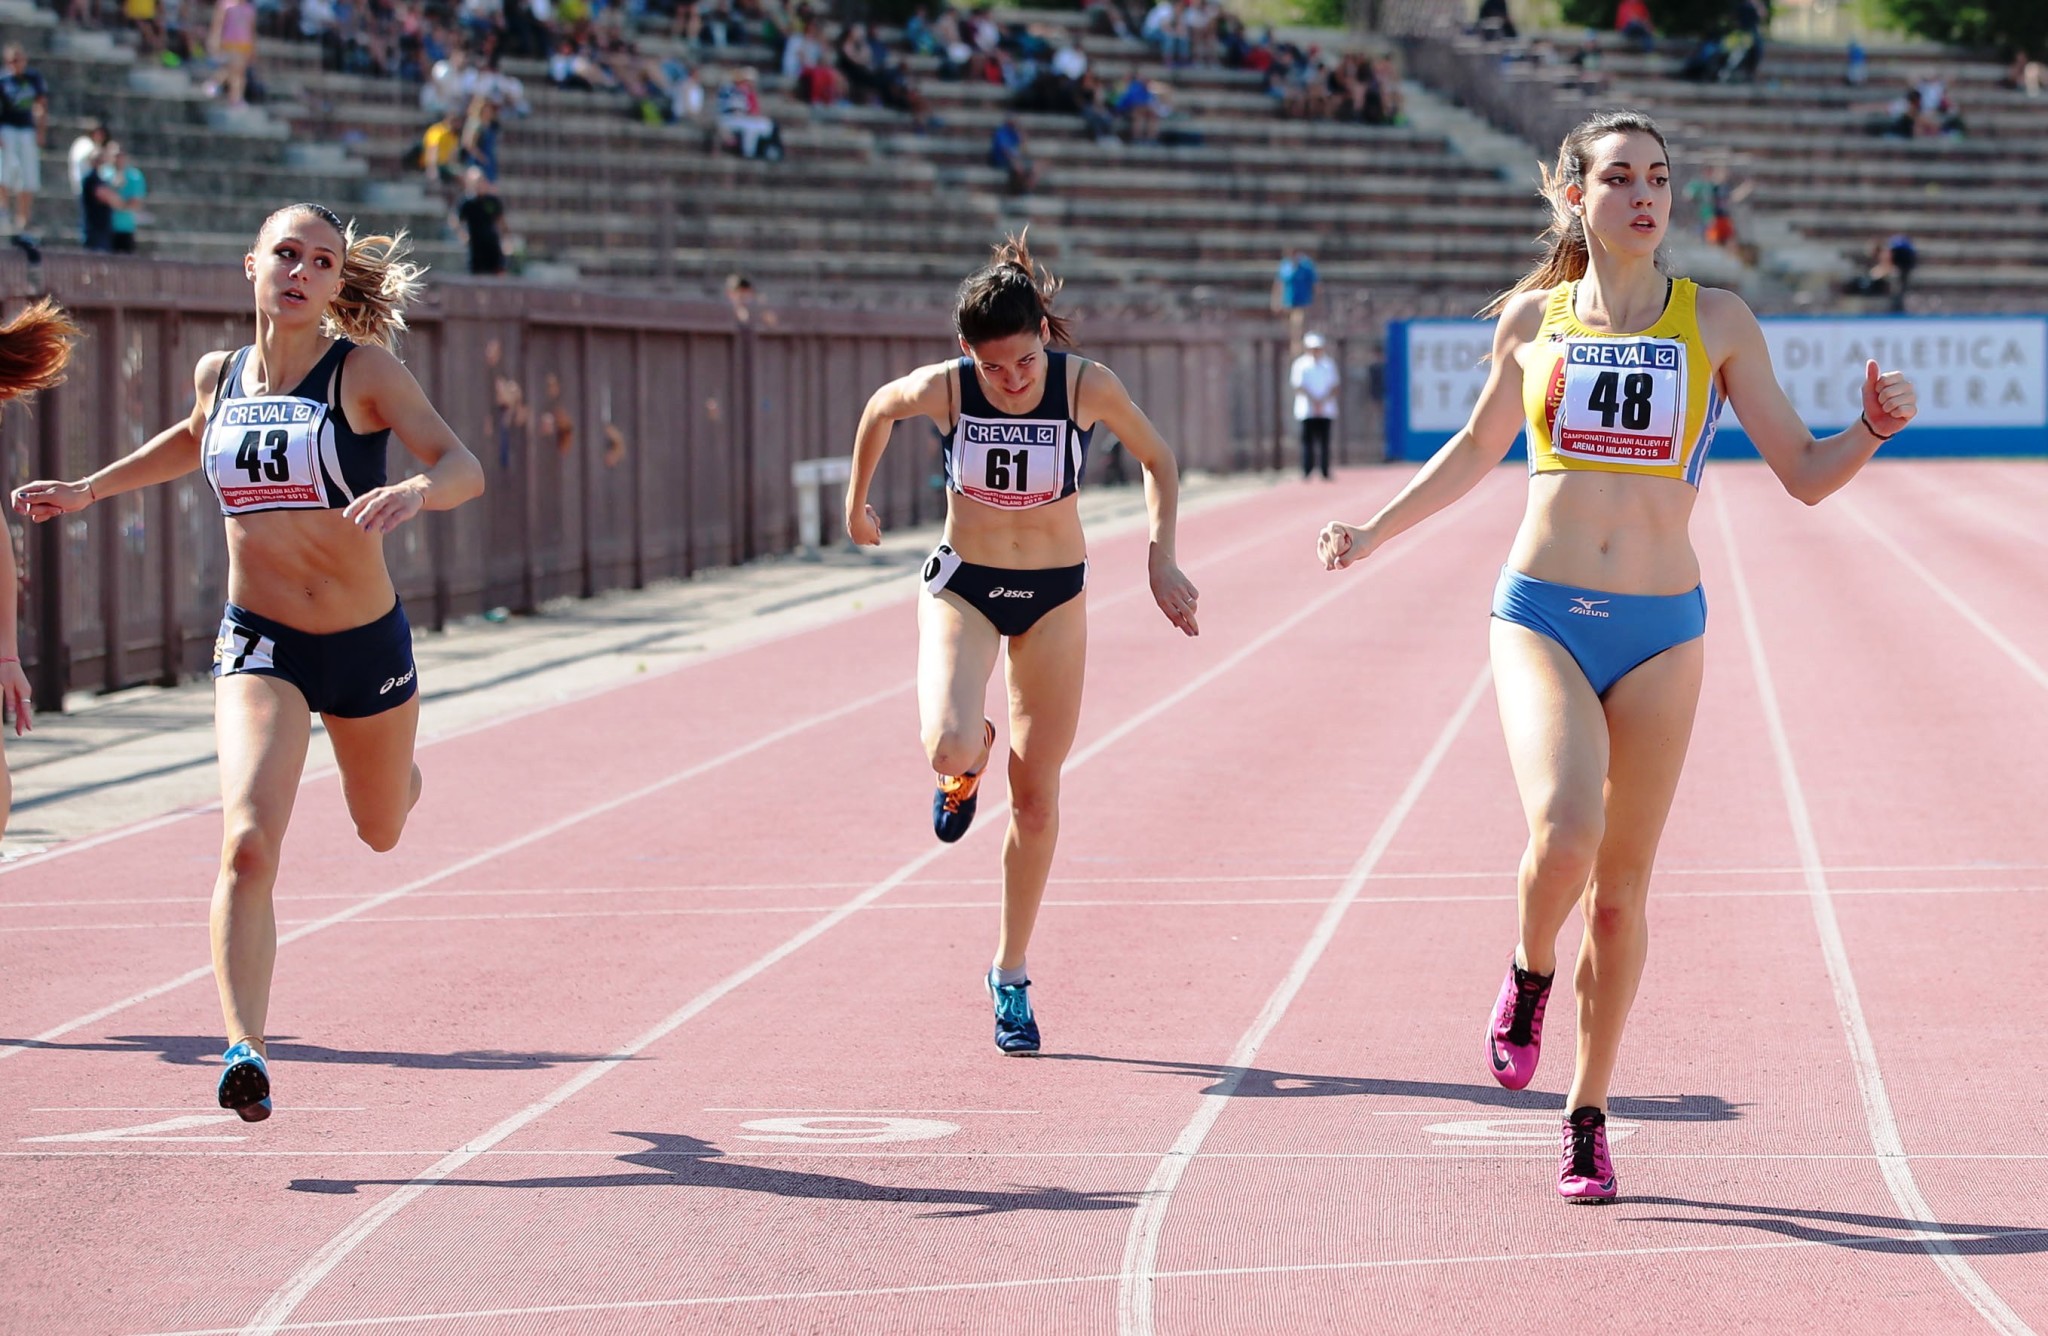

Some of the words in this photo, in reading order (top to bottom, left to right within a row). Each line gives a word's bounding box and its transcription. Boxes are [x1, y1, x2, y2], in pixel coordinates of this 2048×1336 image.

[1572, 345, 1651, 366] CREVAL
[1784, 336, 1820, 370] DI
[1844, 336, 2027, 370] ATLETICA
[1588, 371, 1653, 430] 48
[226, 404, 289, 424] CREVAL
[967, 424, 1033, 443] CREVAL
[1562, 432, 1605, 442] CAMPIONATI
[1605, 435, 1634, 445] ITALIANI
[1635, 439, 1660, 447] ALLIEVI
[235, 429, 290, 482] 43
[1571, 441, 1595, 452] ARENA
[1596, 445, 1604, 453] DI
[1605, 447, 1632, 455] MILANO
[1634, 448, 1658, 457] 2015
[985, 448, 1028, 492] 61
[1003, 589, 1034, 599] asics
[233, 625, 262, 669] 7
